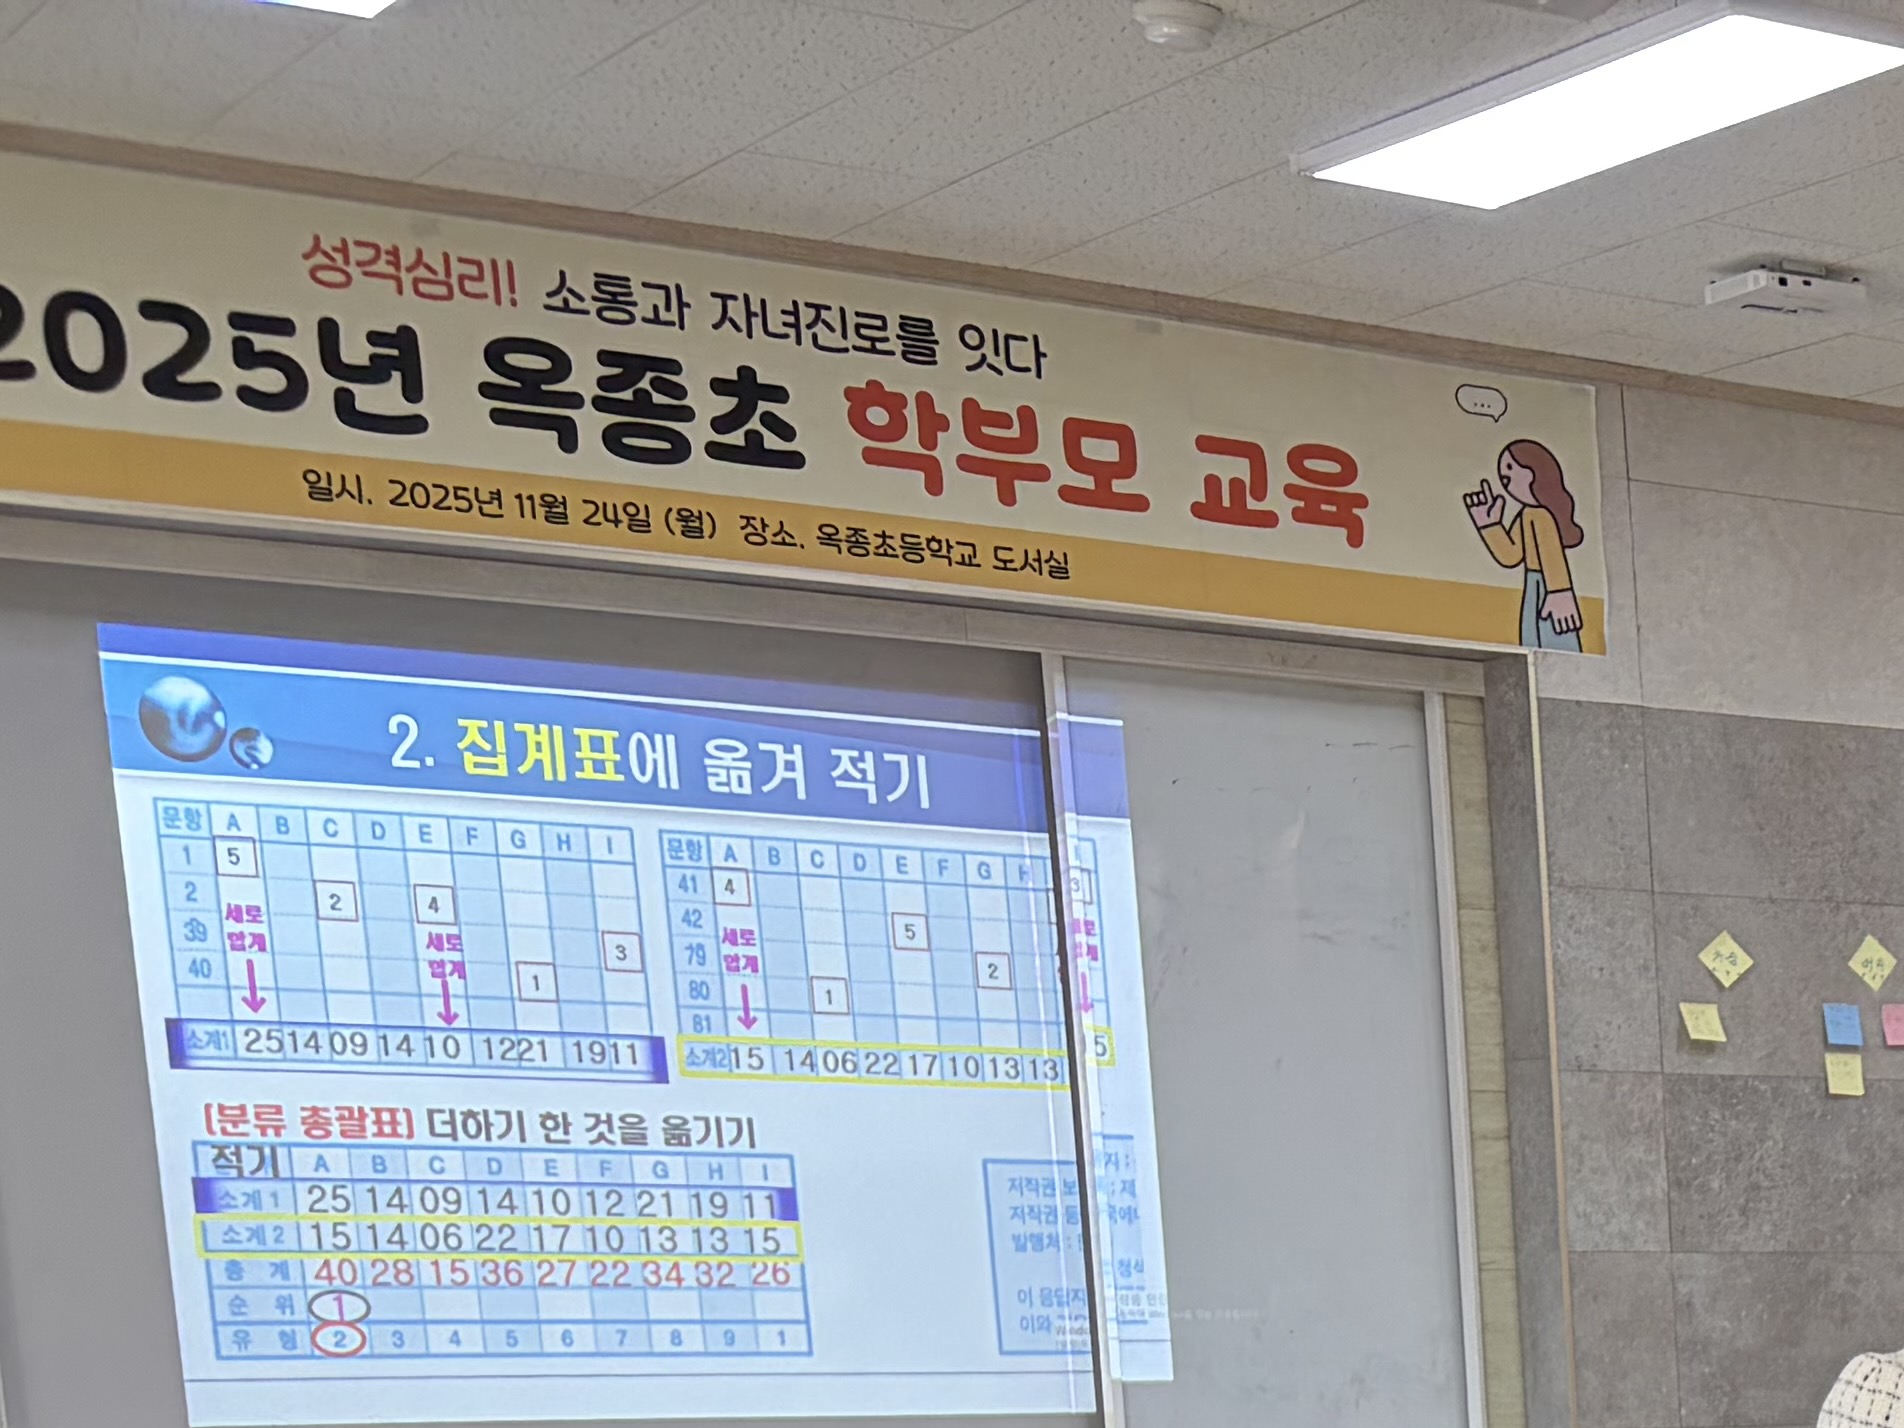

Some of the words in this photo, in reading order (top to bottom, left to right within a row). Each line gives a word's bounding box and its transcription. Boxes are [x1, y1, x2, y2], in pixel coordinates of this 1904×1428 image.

[302, 234, 517, 307] 성격심리!
[543, 269, 692, 331] 소통과
[710, 290, 940, 366] 자녀진로를
[958, 323, 1048, 379] 잇다
[477, 336, 807, 470] 옥종초
[843, 379, 1151, 513] 학부모
[1190, 434, 1369, 549] 교육
[302, 469, 373, 504] 일시.
[388, 479, 505, 520] 2025년
[514, 492, 569, 525] 11월
[582, 497, 652, 535] 24일
[665, 504, 717, 541] (월)
[739, 514, 805, 552] 장소.
[816, 522, 982, 570] 옥종초등학교
[992, 544, 1071, 582] 도서실
[387, 715, 436, 769] 2.
[457, 718, 679, 790] 집계표에
[704, 737, 807, 801] 옮겨
[830, 747, 931, 810] 적기
[226, 812, 242, 832] A
[275, 816, 290, 835] B
[323, 818, 339, 838] C
[371, 821, 386, 841] D
[418, 823, 433, 844] E
[466, 826, 479, 846] F
[510, 829, 527, 849] G
[557, 832, 571, 852] H
[607, 836, 613, 855] I
[227, 847, 241, 866] 5
[724, 844, 738, 864] A
[767, 846, 782, 866] B
[810, 849, 825, 869] C
[853, 852, 867, 872] D
[895, 854, 909, 876] E
[937, 858, 949, 878] F
[977, 861, 992, 881] G
[184, 881, 198, 902] 2
[329, 893, 342, 911] 2
[428, 896, 440, 914] 4
[678, 872, 699, 894] 41
[724, 878, 736, 895] 4
[681, 908, 703, 930] 42
[904, 923, 916, 941] 5
[188, 957, 212, 979] 40
[615, 944, 628, 961] 3
[987, 962, 999, 980] 2
[688, 979, 710, 1001] 80
[243, 1027, 285, 1054] 25
[287, 1029, 324, 1055] 14
[329, 1030, 369, 1056] 09
[378, 1032, 415, 1058] 14
[424, 1034, 461, 1060] 10
[482, 1036, 519, 1062] 12
[573, 1040, 607, 1064] 19
[609, 1041, 638, 1066] 11
[732, 1046, 765, 1071] 15
[785, 1048, 817, 1073] 14
[823, 1049, 858, 1074] 06
[864, 1051, 900, 1076] 22
[908, 1053, 938, 1077] 17
[948, 1055, 980, 1078] 10
[989, 1057, 1020, 1080] 13
[1029, 1058, 1059, 1082] 13
[426, 1108, 526, 1143] 더하기
[539, 1112, 573, 1144] 한
[584, 1113, 649, 1146] 것을
[662, 1114, 756, 1149] 옮기기
[211, 1145, 280, 1178] 적기
[313, 1154, 330, 1173] A
[371, 1155, 388, 1173] B
[428, 1156, 446, 1175] C
[487, 1157, 502, 1175] D
[545, 1159, 559, 1177] E
[600, 1159, 613, 1177] F
[652, 1161, 669, 1179] G
[708, 1162, 723, 1180] H
[763, 1163, 769, 1181] I
[307, 1184, 351, 1213] 25
[367, 1185, 408, 1213] 14
[420, 1186, 462, 1214] 09
[477, 1187, 518, 1215] 14
[532, 1188, 571, 1216] 10
[586, 1189, 624, 1216] 12
[637, 1190, 672, 1217] 21
[691, 1191, 728, 1218] 19
[744, 1192, 775, 1219] 11
[310, 1221, 352, 1250] 15
[367, 1221, 408, 1250] 14
[420, 1222, 462, 1251] 06
[475, 1223, 517, 1251] 22
[532, 1224, 570, 1252] 17
[586, 1224, 624, 1253] 10
[640, 1225, 677, 1253] 13
[692, 1226, 729, 1254] 13
[744, 1227, 781, 1255] 15
[314, 1258, 358, 1286] 40
[371, 1258, 415, 1286] 28
[430, 1258, 470, 1286] 15
[481, 1259, 524, 1286] 36
[537, 1259, 576, 1287] 27
[590, 1259, 631, 1287] 22
[641, 1260, 685, 1287] 34
[694, 1260, 736, 1287] 32
[751, 1261, 791, 1288] 26
[333, 1330, 348, 1348] 2
[392, 1331, 405, 1348] 3
[449, 1330, 462, 1348] 4
[506, 1330, 519, 1348] 5
[561, 1329, 574, 1348] 6
[616, 1330, 628, 1347] 7
[670, 1329, 683, 1348] 8
[723, 1330, 735, 1347] 9
[778, 1330, 786, 1346] 1
